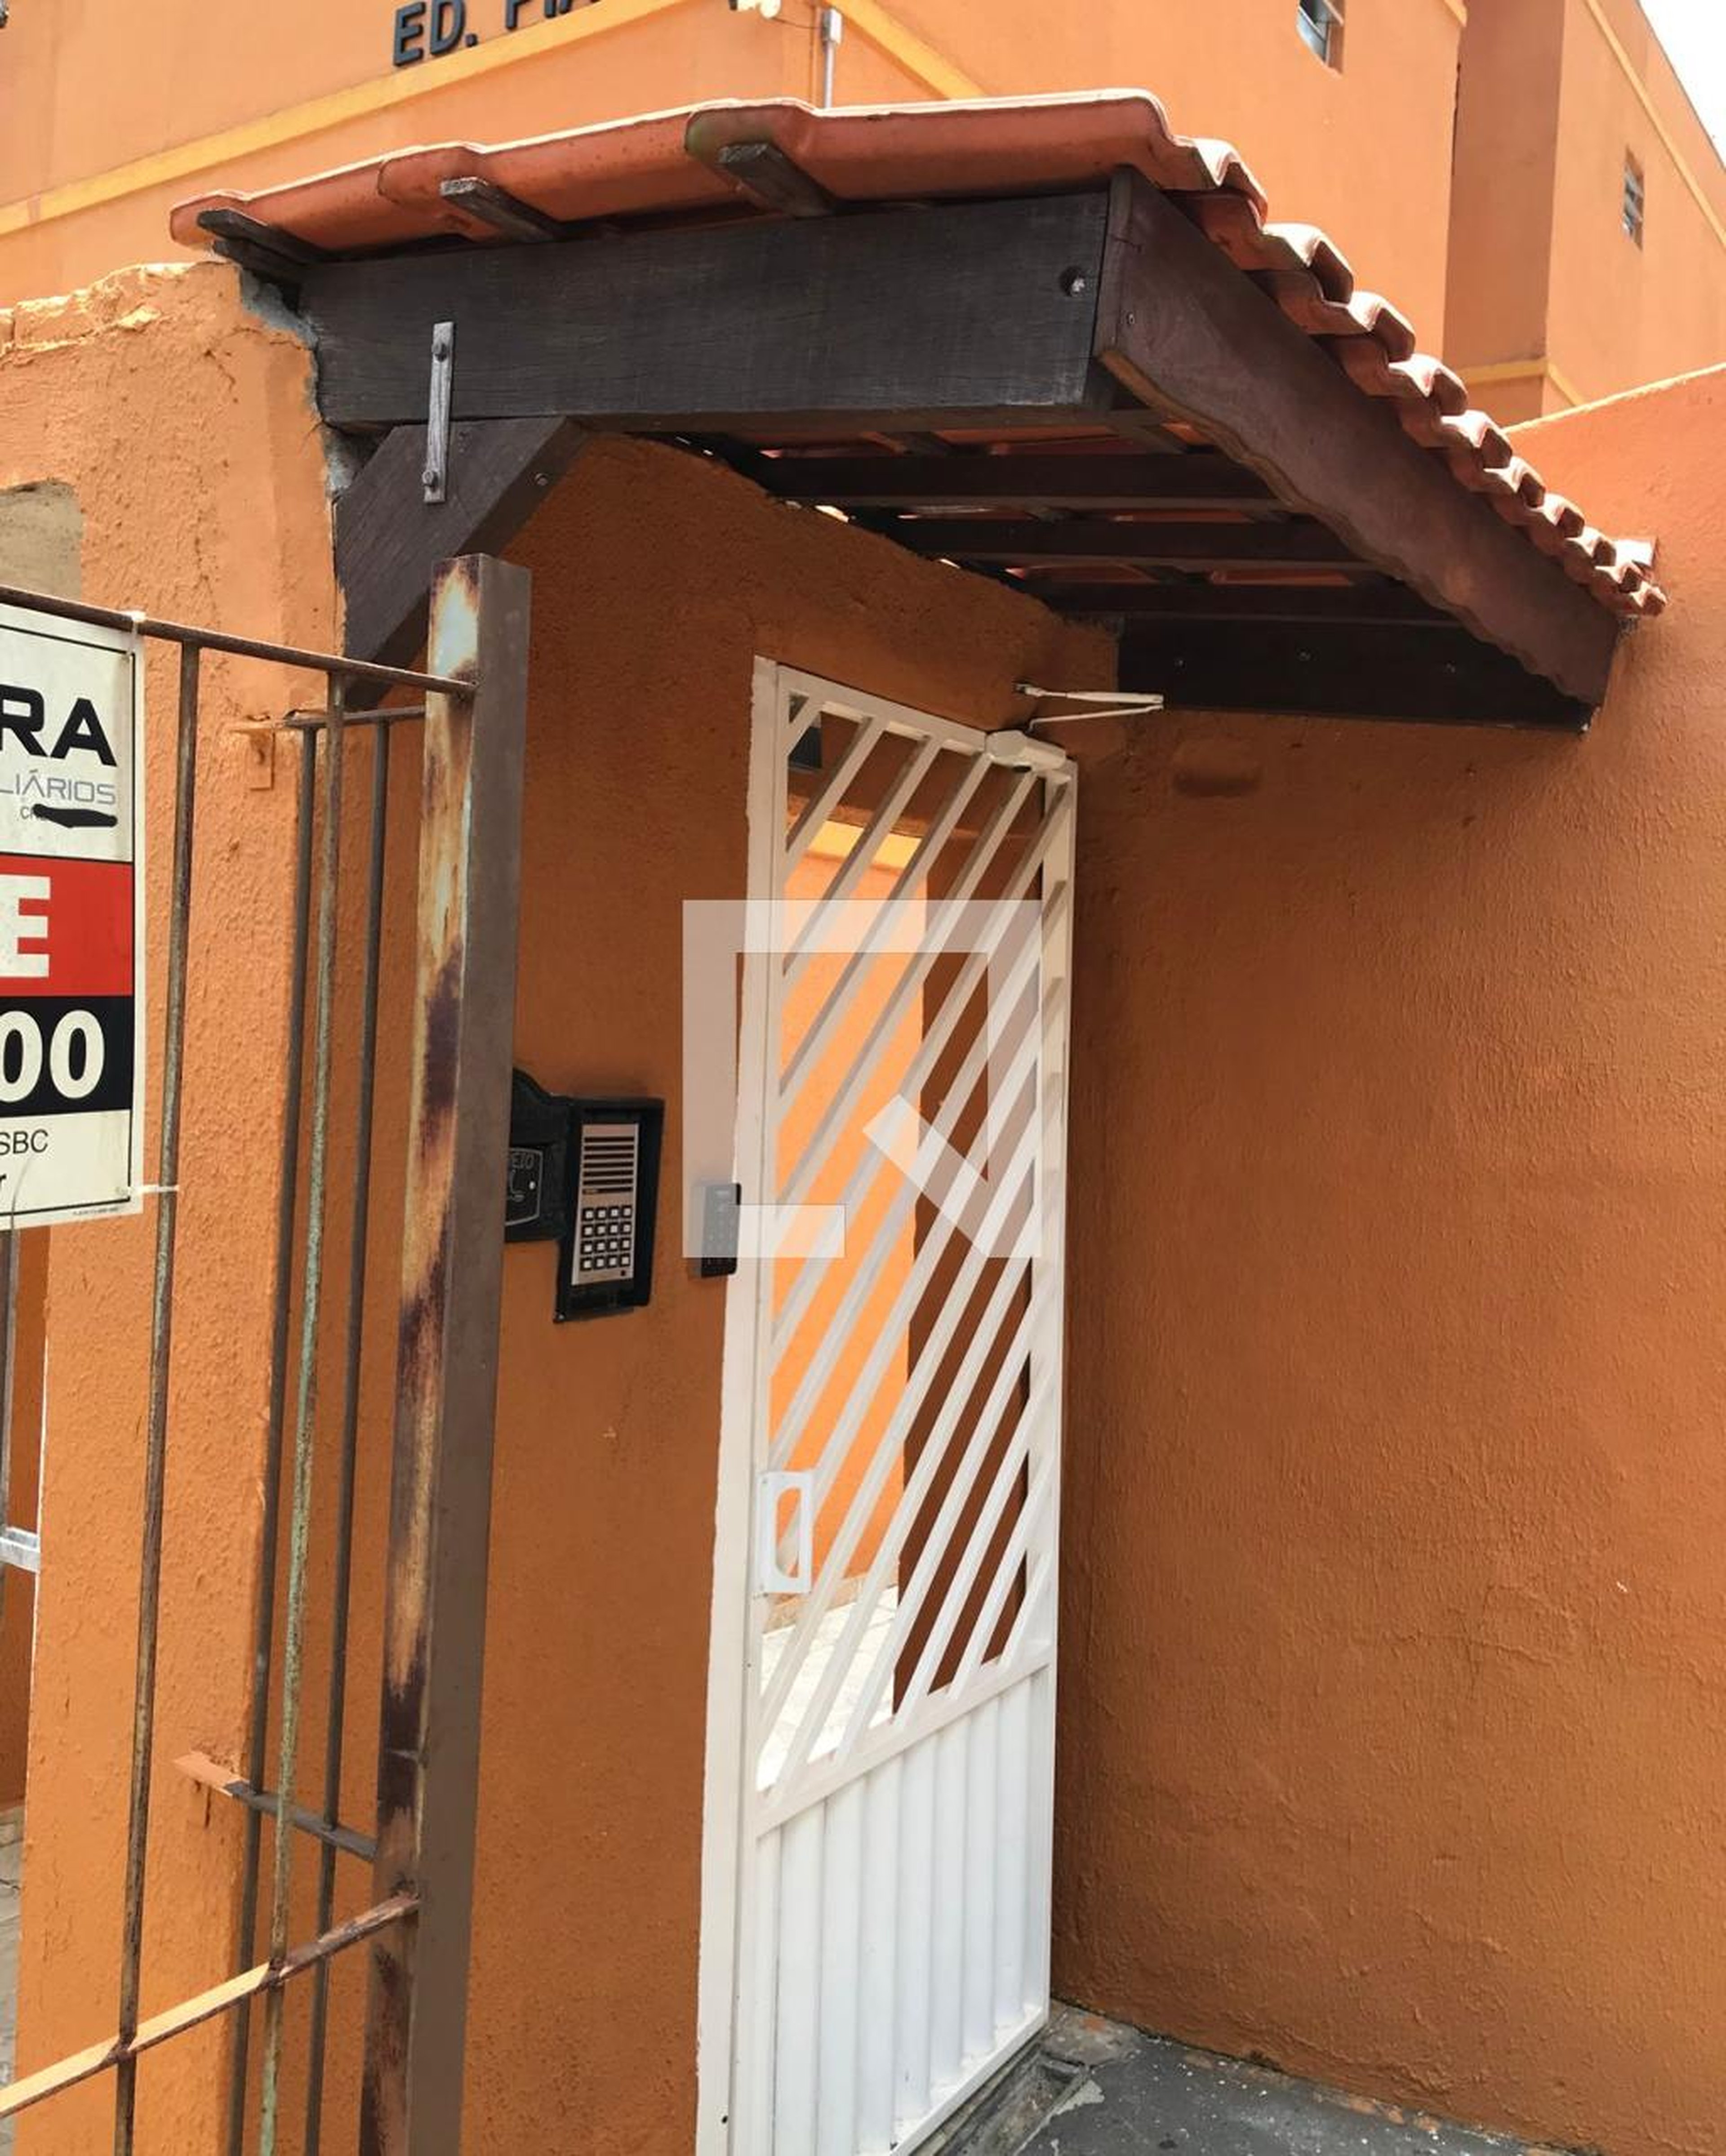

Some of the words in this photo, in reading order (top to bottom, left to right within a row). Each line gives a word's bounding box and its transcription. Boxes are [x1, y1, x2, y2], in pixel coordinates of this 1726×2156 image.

[393, 0, 478, 67] ED.
[0, 684, 117, 766] RA
[0, 1010, 105, 1103] 00
